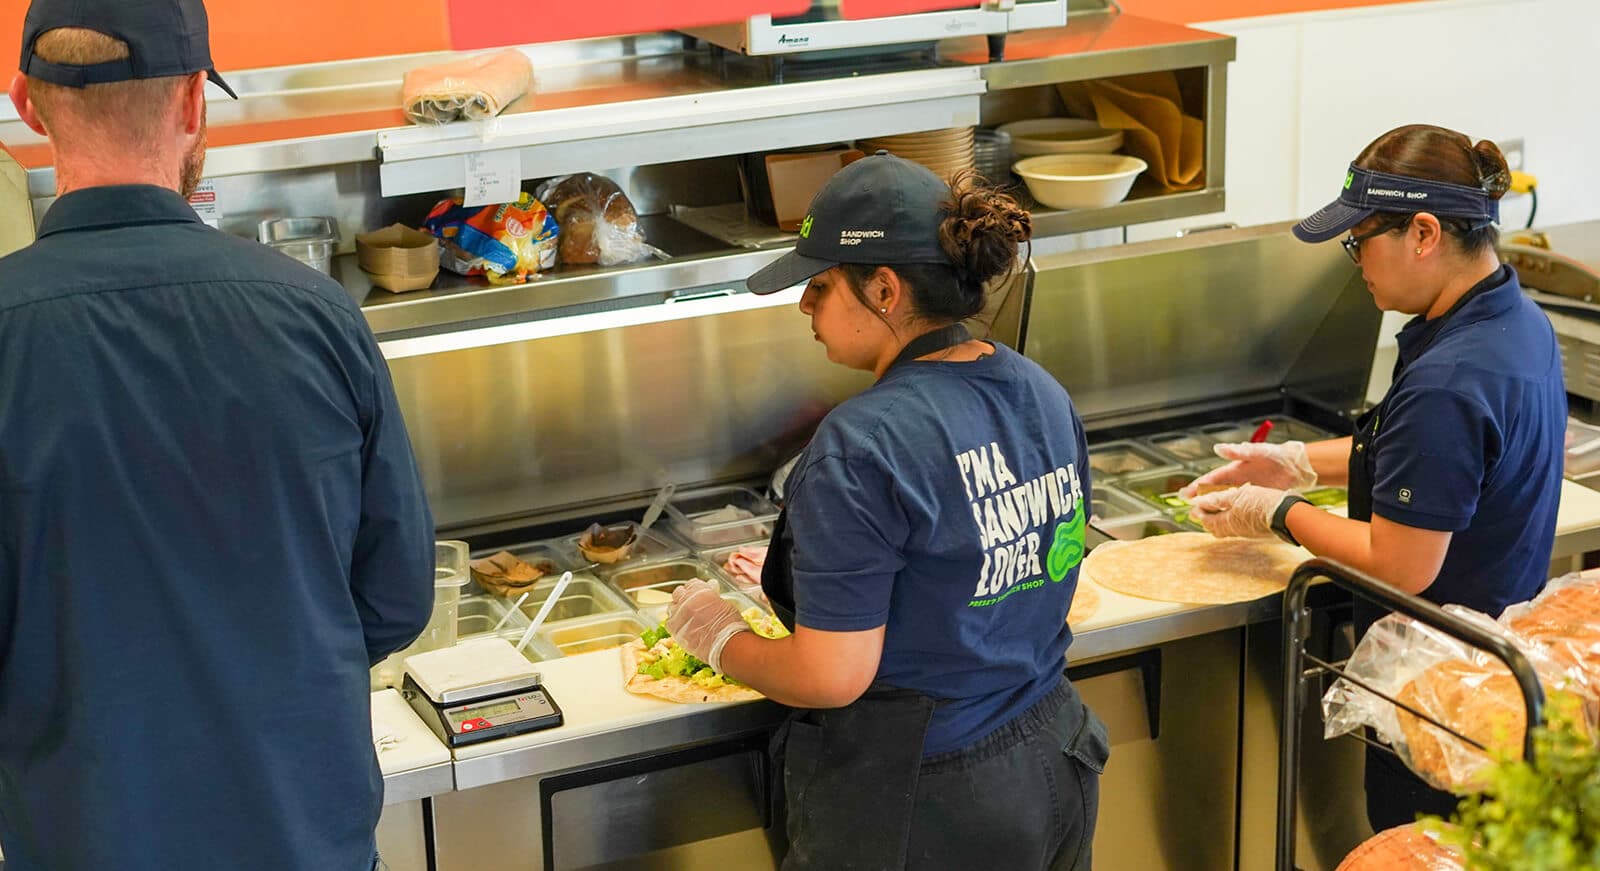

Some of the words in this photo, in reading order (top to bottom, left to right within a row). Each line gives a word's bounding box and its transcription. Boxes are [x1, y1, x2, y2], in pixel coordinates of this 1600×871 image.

[778, 34, 809, 43] Amana
[1367, 188, 1405, 198] SANDWICH
[1407, 192, 1428, 200] SHOP
[955, 446, 997, 502] I'M
[990, 441, 1017, 490] A
[971, 463, 1083, 551] SANDWICH
[973, 531, 1043, 598] LOVER
[1021, 579, 1045, 591] SHOP
